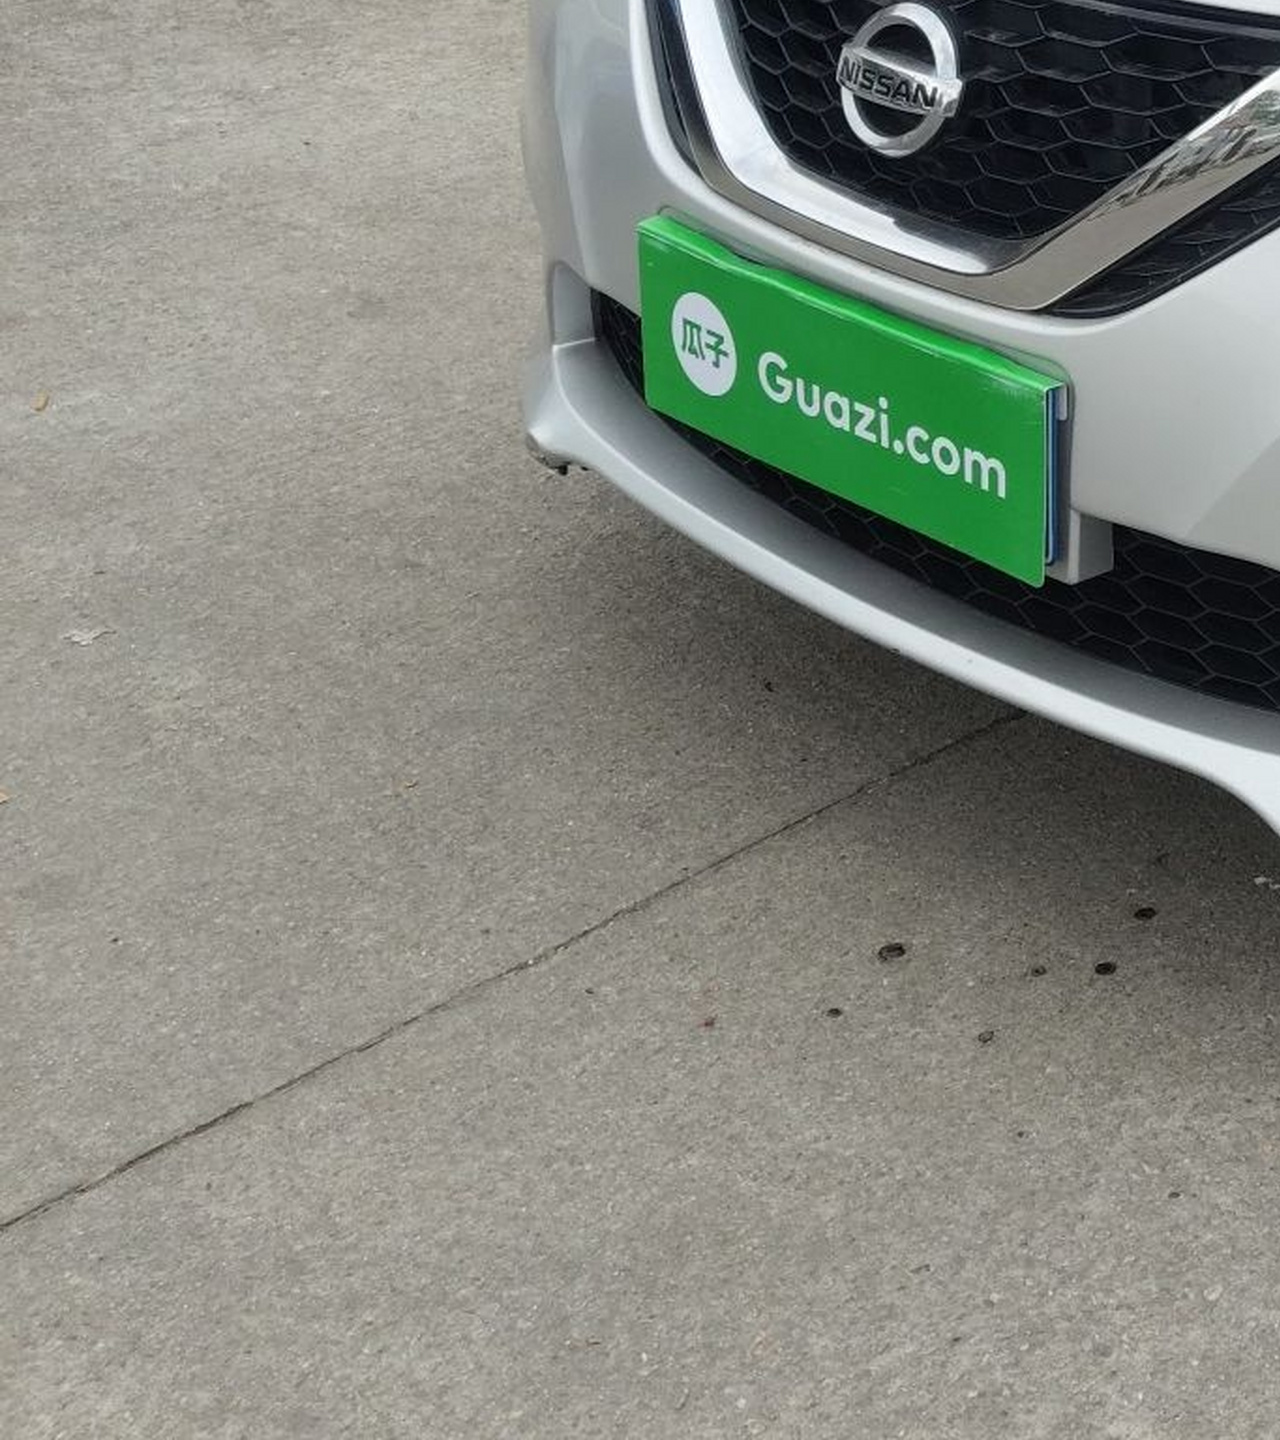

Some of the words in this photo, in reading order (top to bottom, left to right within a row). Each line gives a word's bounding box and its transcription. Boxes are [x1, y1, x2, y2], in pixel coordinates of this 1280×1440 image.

[839, 55, 940, 108] NISSAN
[682, 317, 730, 369] 瓜子
[757, 351, 1007, 500] Guazi.com
